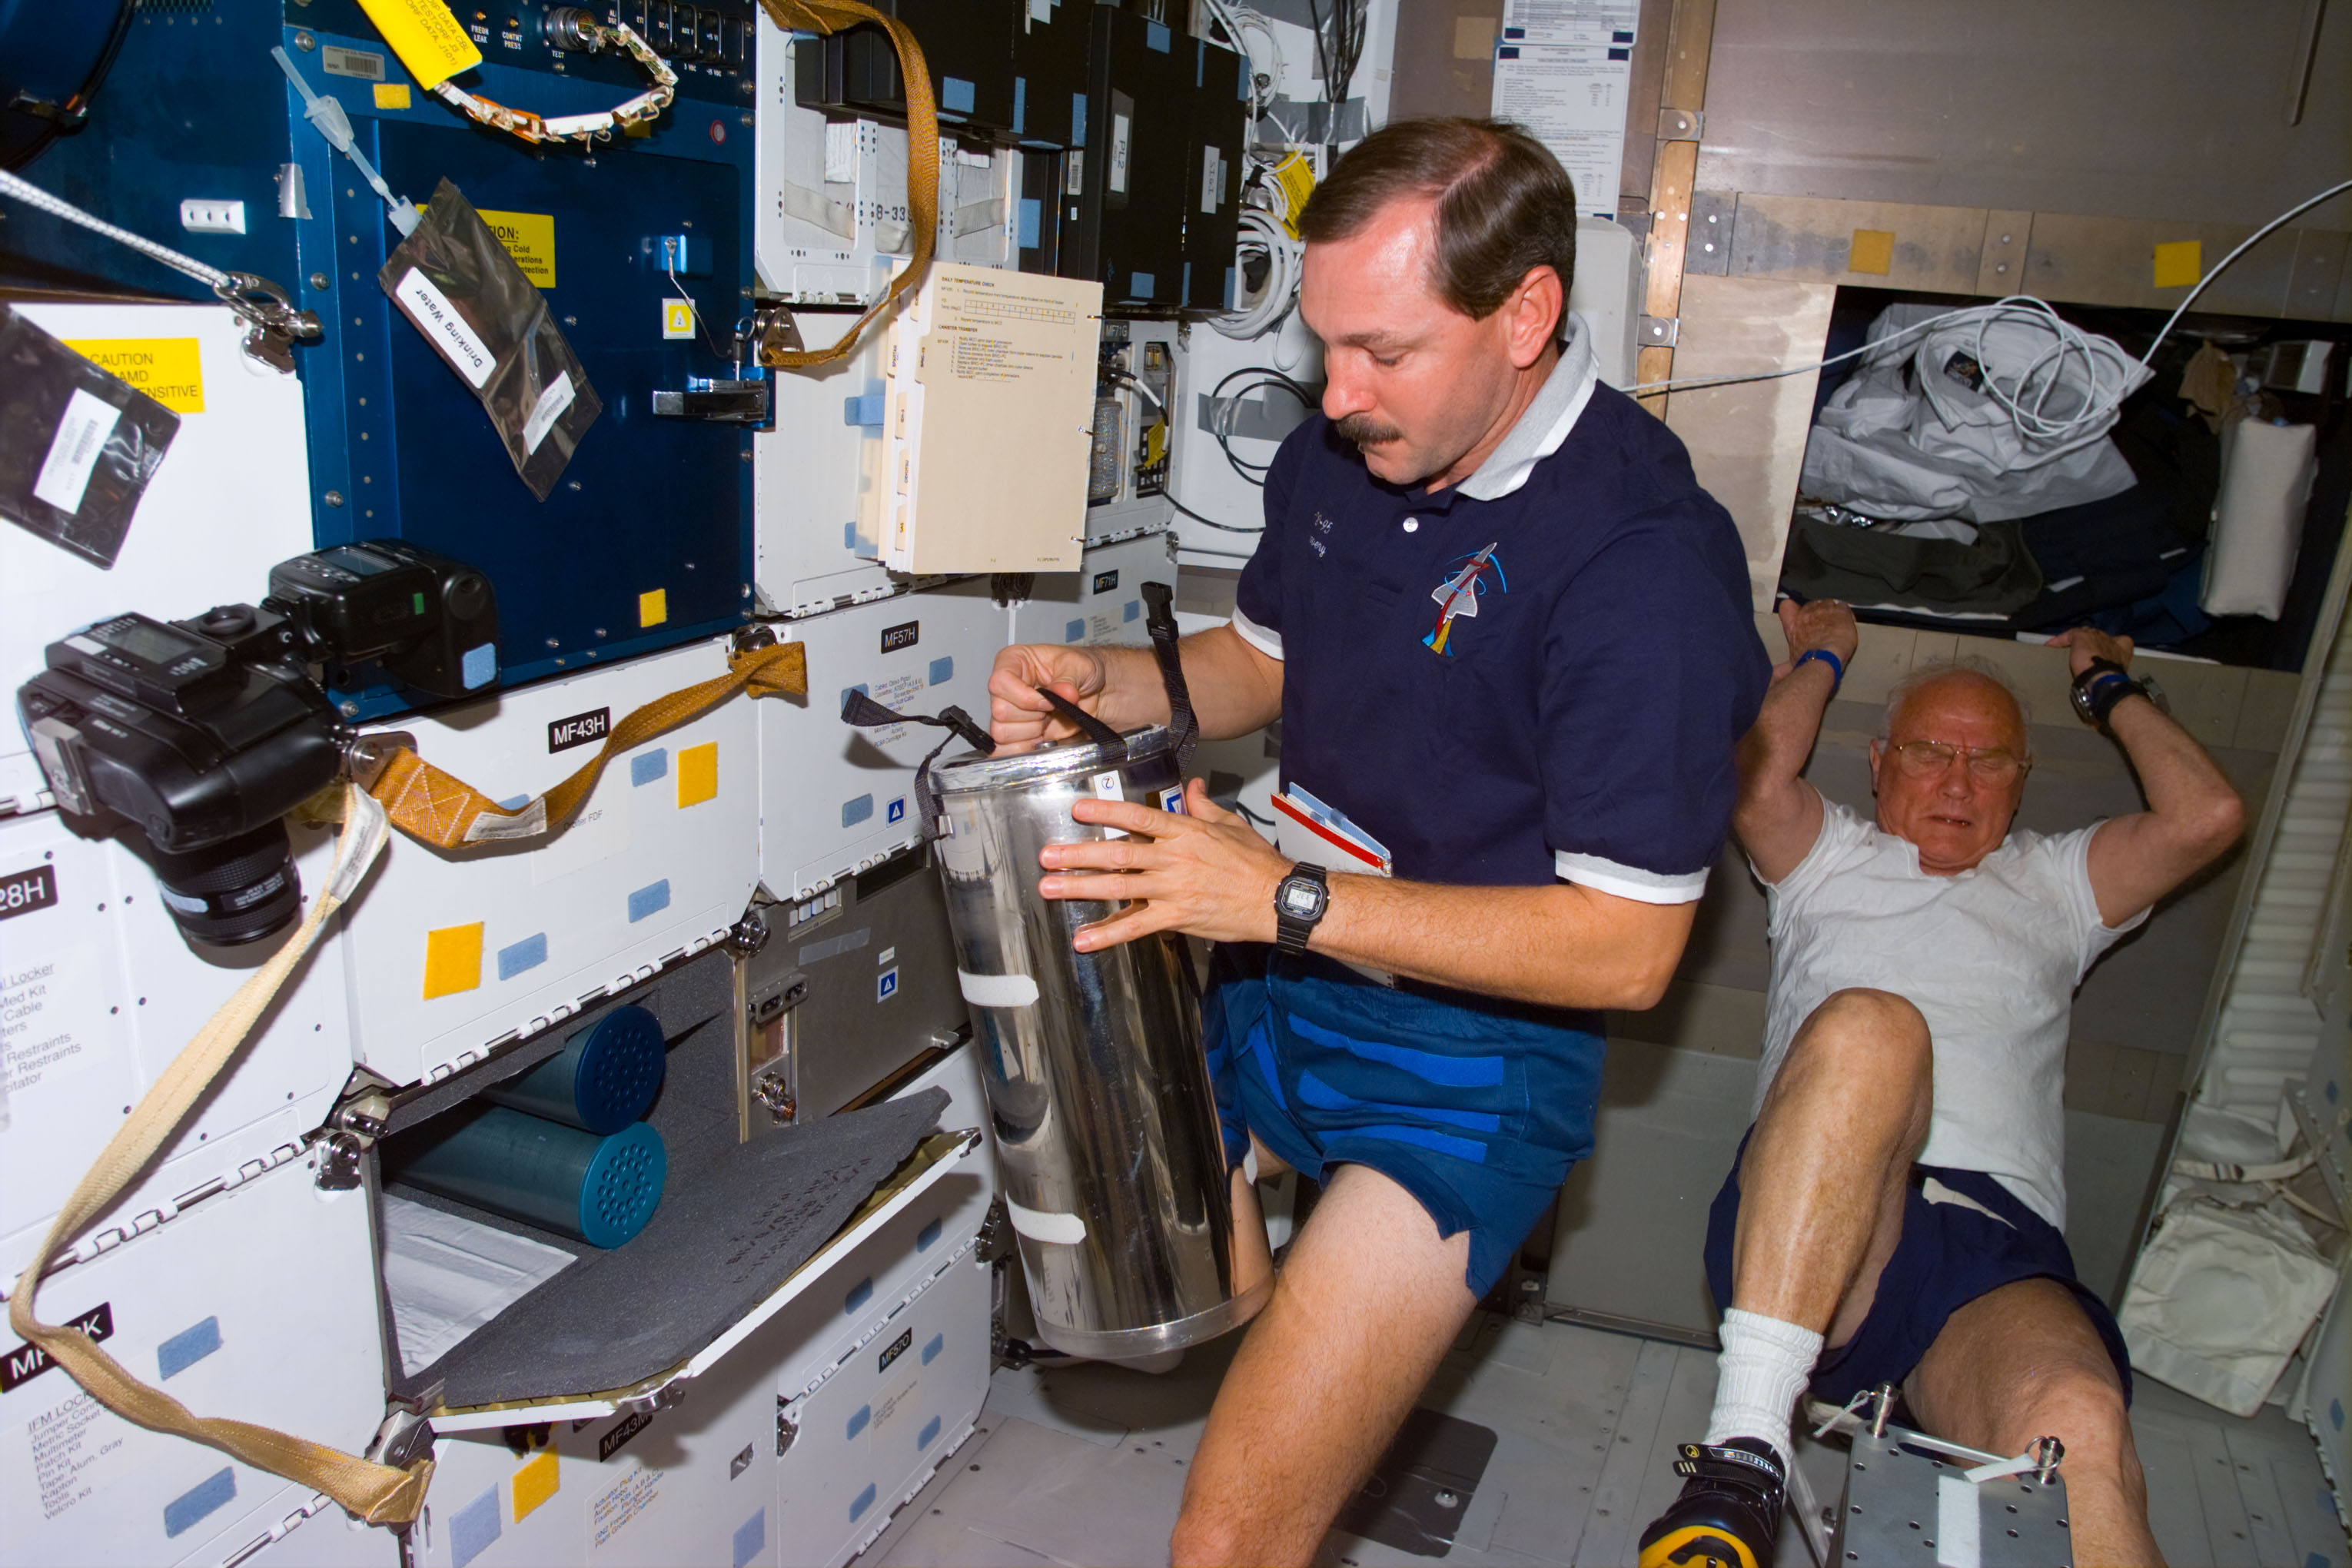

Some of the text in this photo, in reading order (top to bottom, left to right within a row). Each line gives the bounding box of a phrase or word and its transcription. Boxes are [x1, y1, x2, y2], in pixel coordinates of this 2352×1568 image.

[438, 12, 457, 35] DATA
[473, 34, 487, 44] LEAK
[504, 41, 522, 51] PRESS
[552, 50, 565, 58] TEST
[1118, 140, 1126, 170] PL2
[513, 244, 530, 254] Cold
[514, 255, 543, 265] erations
[521, 265, 549, 274] otection
[416, 288, 483, 368] Drinking Water
[1105, 324, 1128, 337] MF71G
[89, 353, 154, 366] CAUTION
[1095, 573, 1117, 590] MF71H
[885, 626, 915, 648] MF57H
[553, 714, 605, 746] MF43H
[588, 809, 603, 823] FDF
[11, 962, 54, 985] Locker
[28, 984, 47, 1001] Kit
[3, 1001, 42, 1023] Cable
[7, 1032, 71, 1065] Restraints
[18, 1042, 82, 1075] Restraints
[11, 1314, 103, 1380] MFK
[28, 1411, 52, 1433] IFM
[31, 1420, 68, 1444] Jumper
[32, 1410, 101, 1453] Metric Socket
[604, 1415, 649, 1453] MF43M
[35, 1428, 87, 1463] Multimeter
[36, 1441, 82, 1472] Patch Kit
[100, 1437, 123, 1456] Gray
[38, 1458, 71, 1483] Pin Kit
[41, 1477, 77, 1501] Kapton
[43, 1492, 70, 1510] Tools
[44, 1486, 92, 1520] Velcro Kit
